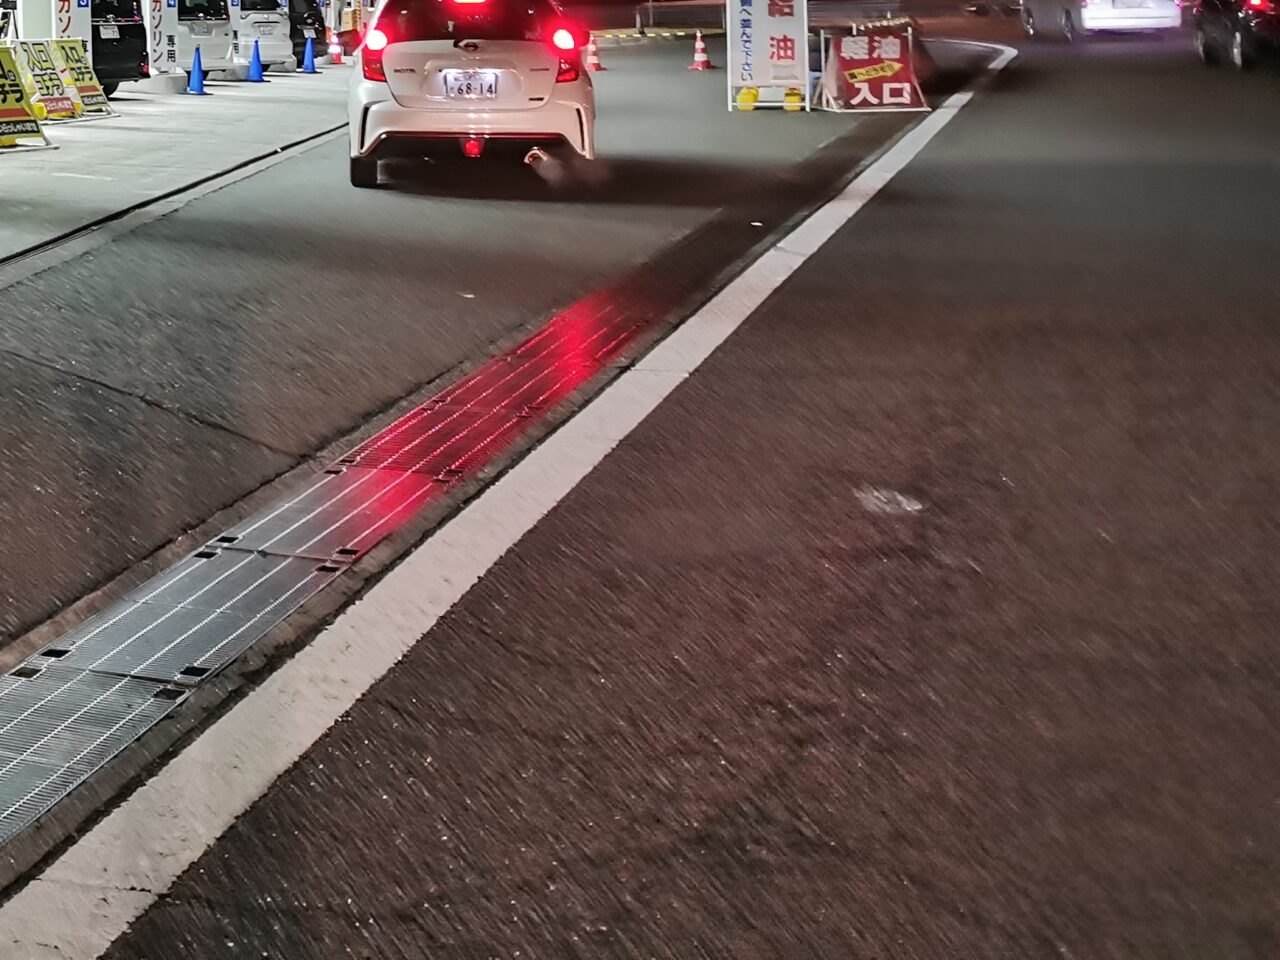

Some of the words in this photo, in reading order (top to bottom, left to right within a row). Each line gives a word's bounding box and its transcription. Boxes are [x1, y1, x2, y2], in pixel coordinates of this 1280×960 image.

[20, 41, 56, 72] 入口
[166, 34, 177, 63] 専用
[840, 35, 901, 60] 軽油
[32, 71, 65, 97] コチラ
[68, 65, 94, 83] コチラ
[849, 82, 912, 106] 入口
